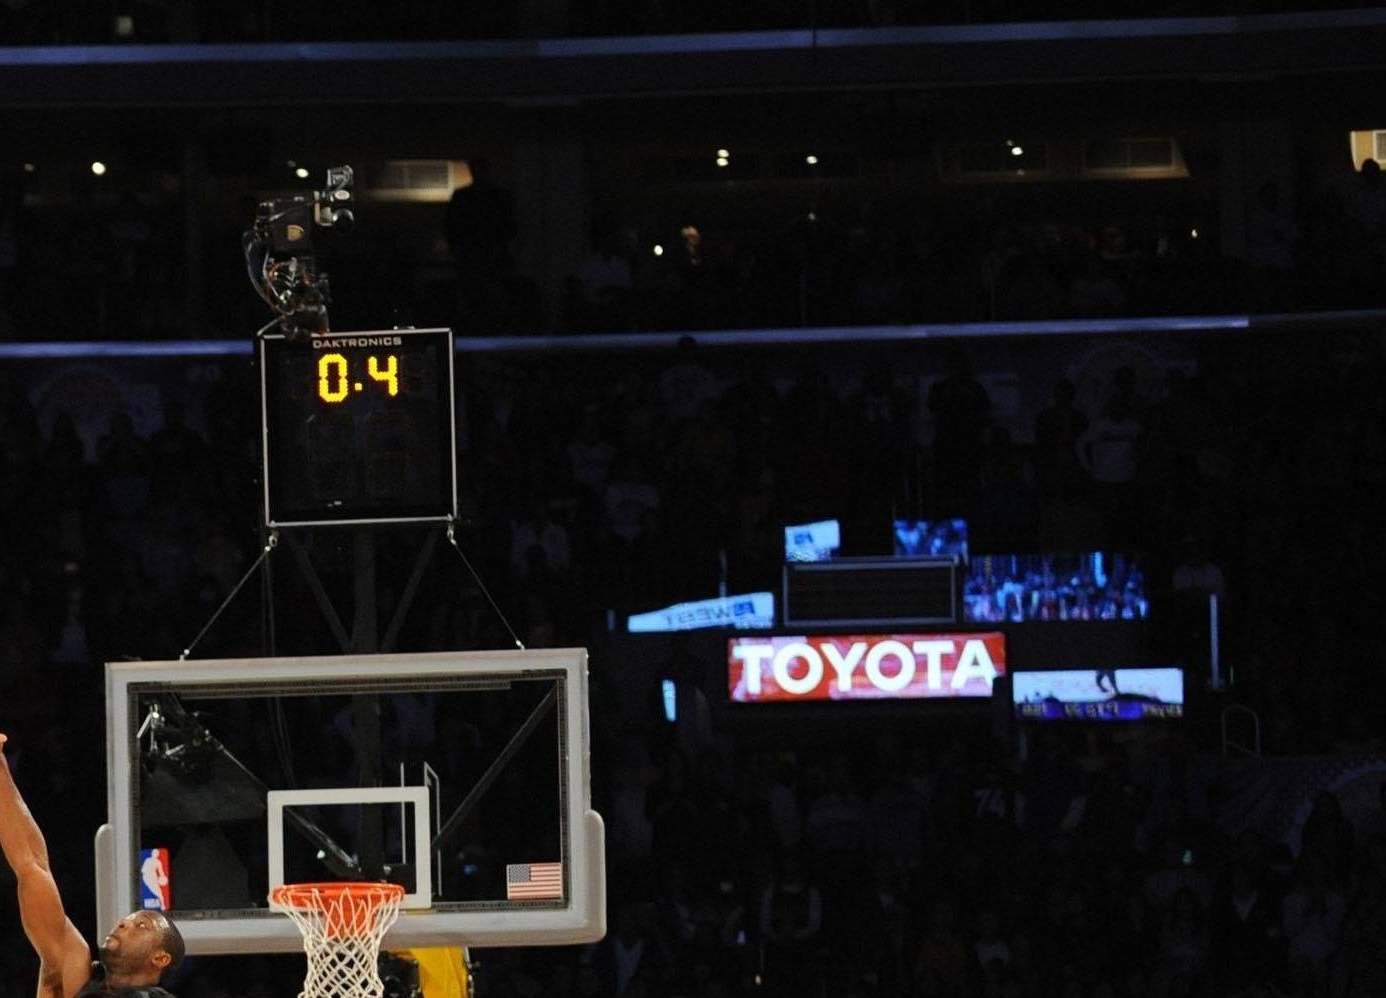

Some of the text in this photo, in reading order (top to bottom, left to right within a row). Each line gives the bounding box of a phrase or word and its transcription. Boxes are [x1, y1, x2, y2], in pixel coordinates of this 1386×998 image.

[312, 336, 402, 349] DAKTRONICS
[318, 353, 398, 402] 0.4
[731, 638, 998, 696] TOYOTA
